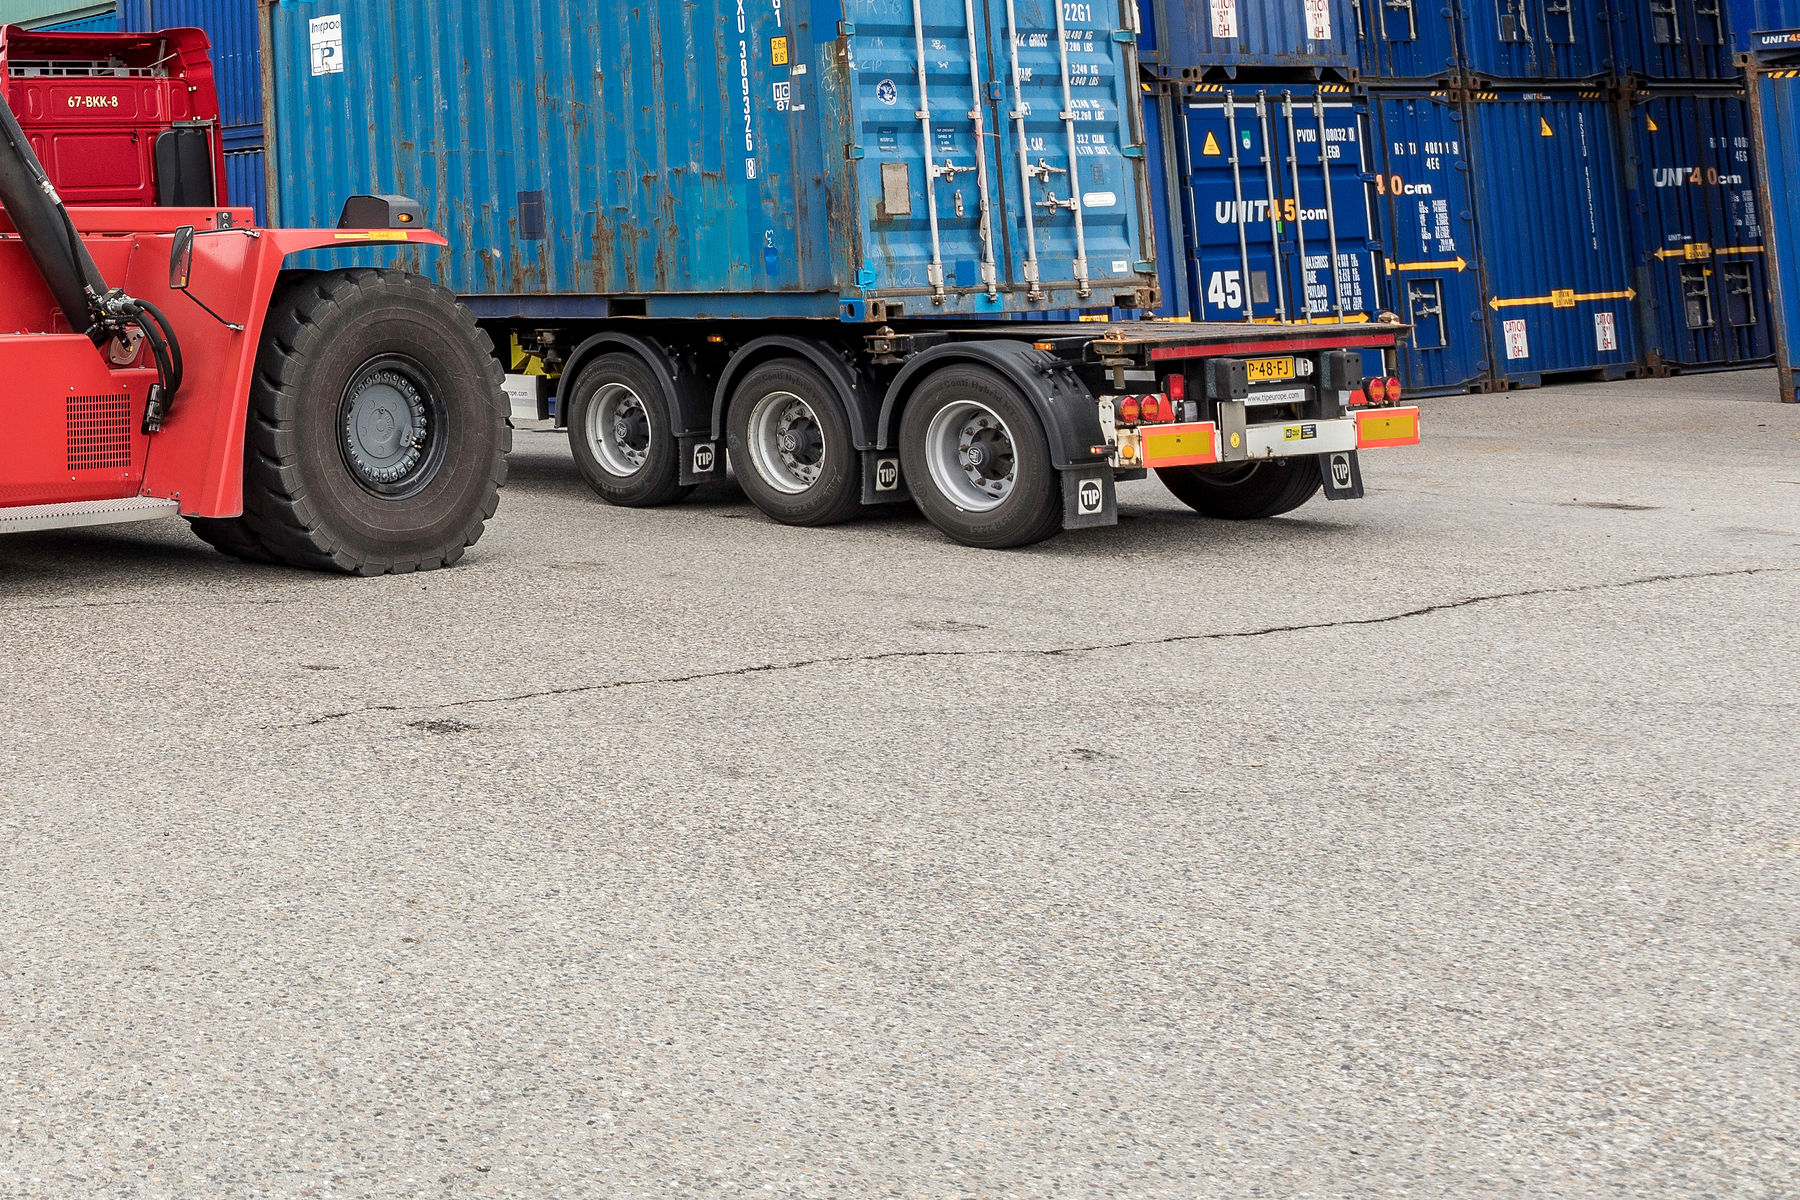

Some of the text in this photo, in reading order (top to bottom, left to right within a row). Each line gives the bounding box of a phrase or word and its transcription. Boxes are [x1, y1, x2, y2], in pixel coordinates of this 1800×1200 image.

[1064, 3, 1091, 22] 22G1
[67, 96, 118, 108] 67-BKK-8
[738, 40, 754, 151] 389326
[746, 158, 756, 179] 8
[776, 100, 790, 111] 87
[1297, 128, 1316, 143] PVDU
[1325, 128, 1347, 142] 08032
[1215, 199, 1327, 224] UNIT45com
[1207, 270, 1241, 309] 45
[695, 452, 712, 467] TIP
[879, 467, 896, 483] TIP
[1333, 462, 1348, 480] TIP
[1081, 489, 1100, 506] TIP
